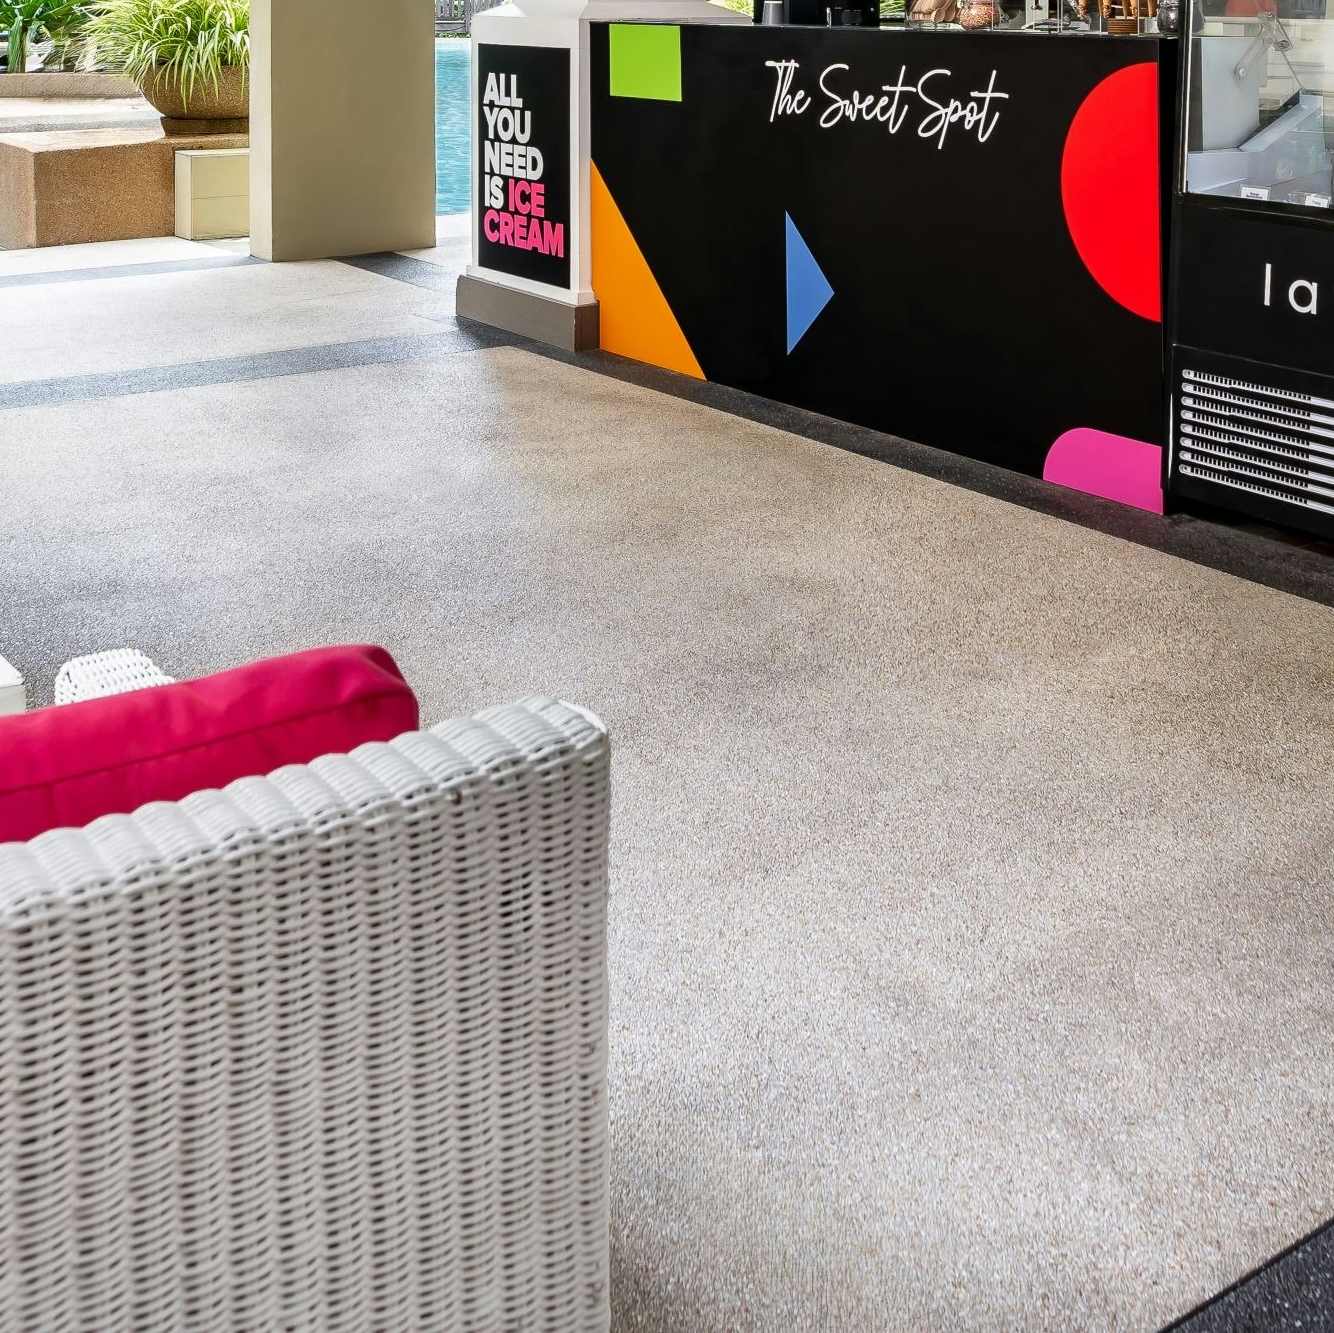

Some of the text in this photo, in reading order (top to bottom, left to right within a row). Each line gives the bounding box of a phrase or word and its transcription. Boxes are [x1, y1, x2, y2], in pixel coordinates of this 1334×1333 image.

[483, 72, 523, 108] ALL
[765, 59, 1009, 150] The Sweet Spot
[483, 105, 531, 144] YOU
[484, 140, 544, 181] NEED
[484, 174, 545, 217] IS ICE
[484, 209, 564, 258] CREAM
